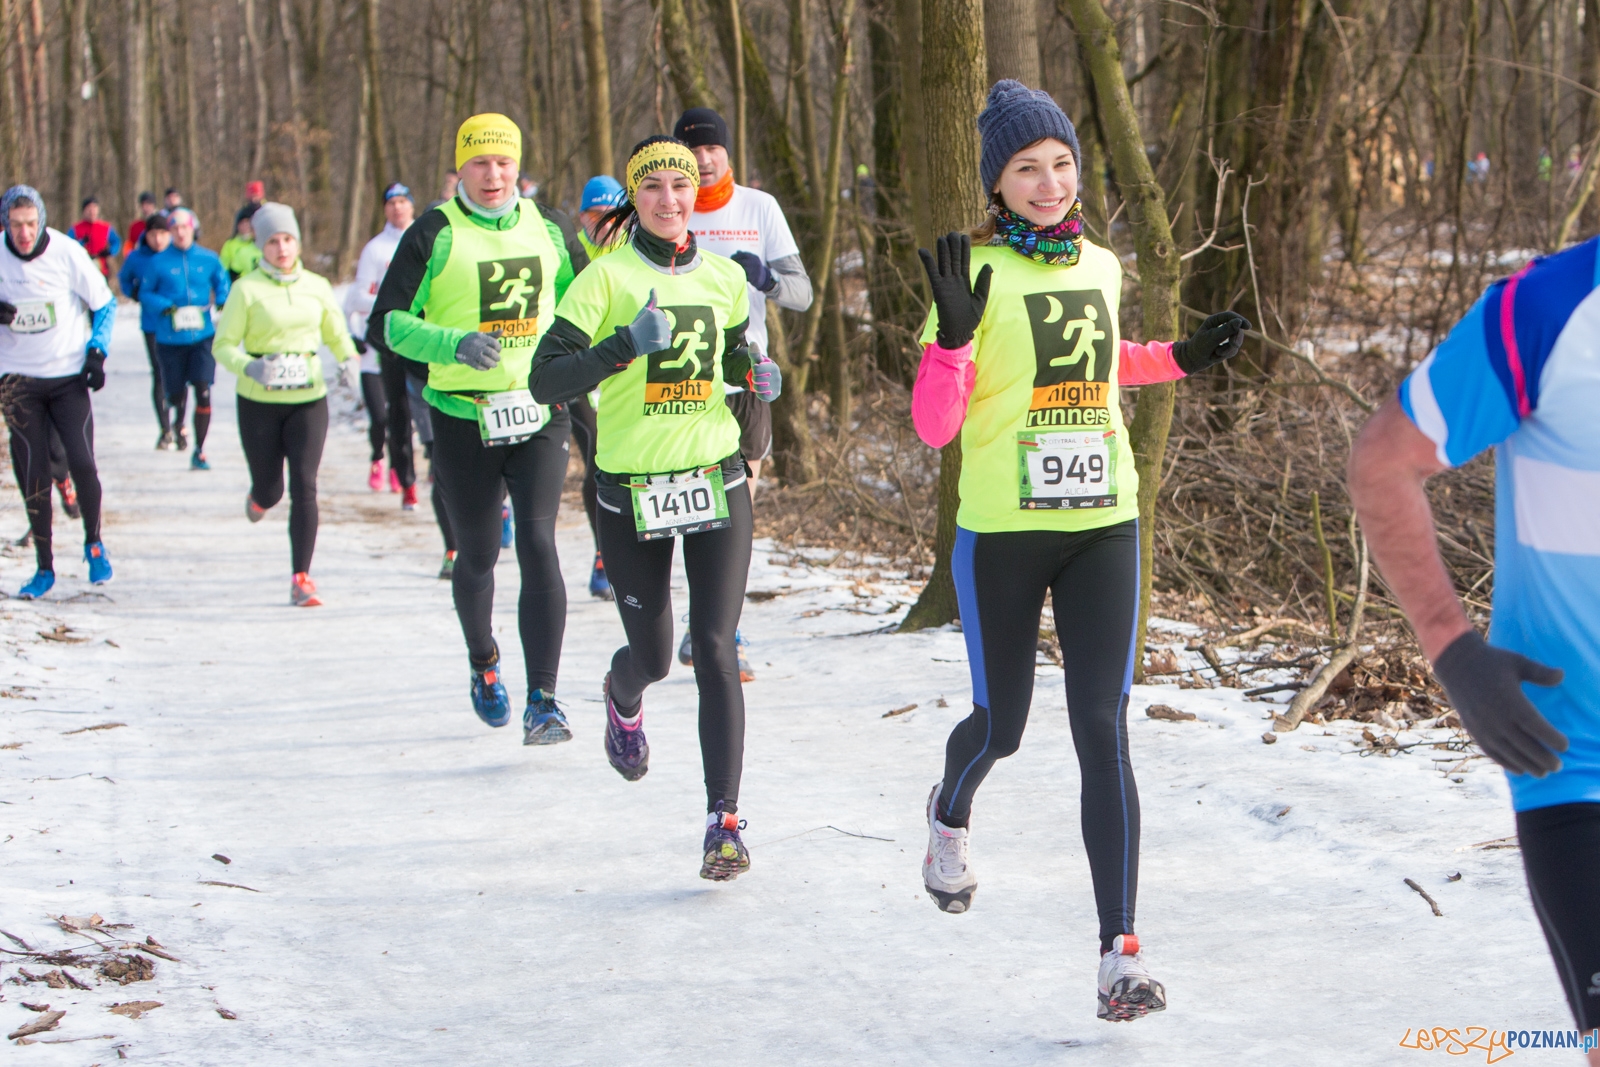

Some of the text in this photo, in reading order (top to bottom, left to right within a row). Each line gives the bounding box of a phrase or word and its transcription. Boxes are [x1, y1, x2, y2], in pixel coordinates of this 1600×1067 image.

[483, 129, 512, 139] night
[473, 137, 517, 149] runners
[16, 313, 47, 326] 434
[492, 320, 530, 336] night
[498, 335, 537, 348] nners
[1048, 382, 1101, 406] night
[491, 404, 539, 428] 1100
[1027, 408, 1111, 427] runners
[1042, 454, 1104, 485] 949
[1064, 487, 1089, 495] ALICIA
[648, 487, 711, 518] 1410
[665, 515, 700, 526] AGNIESZKA
